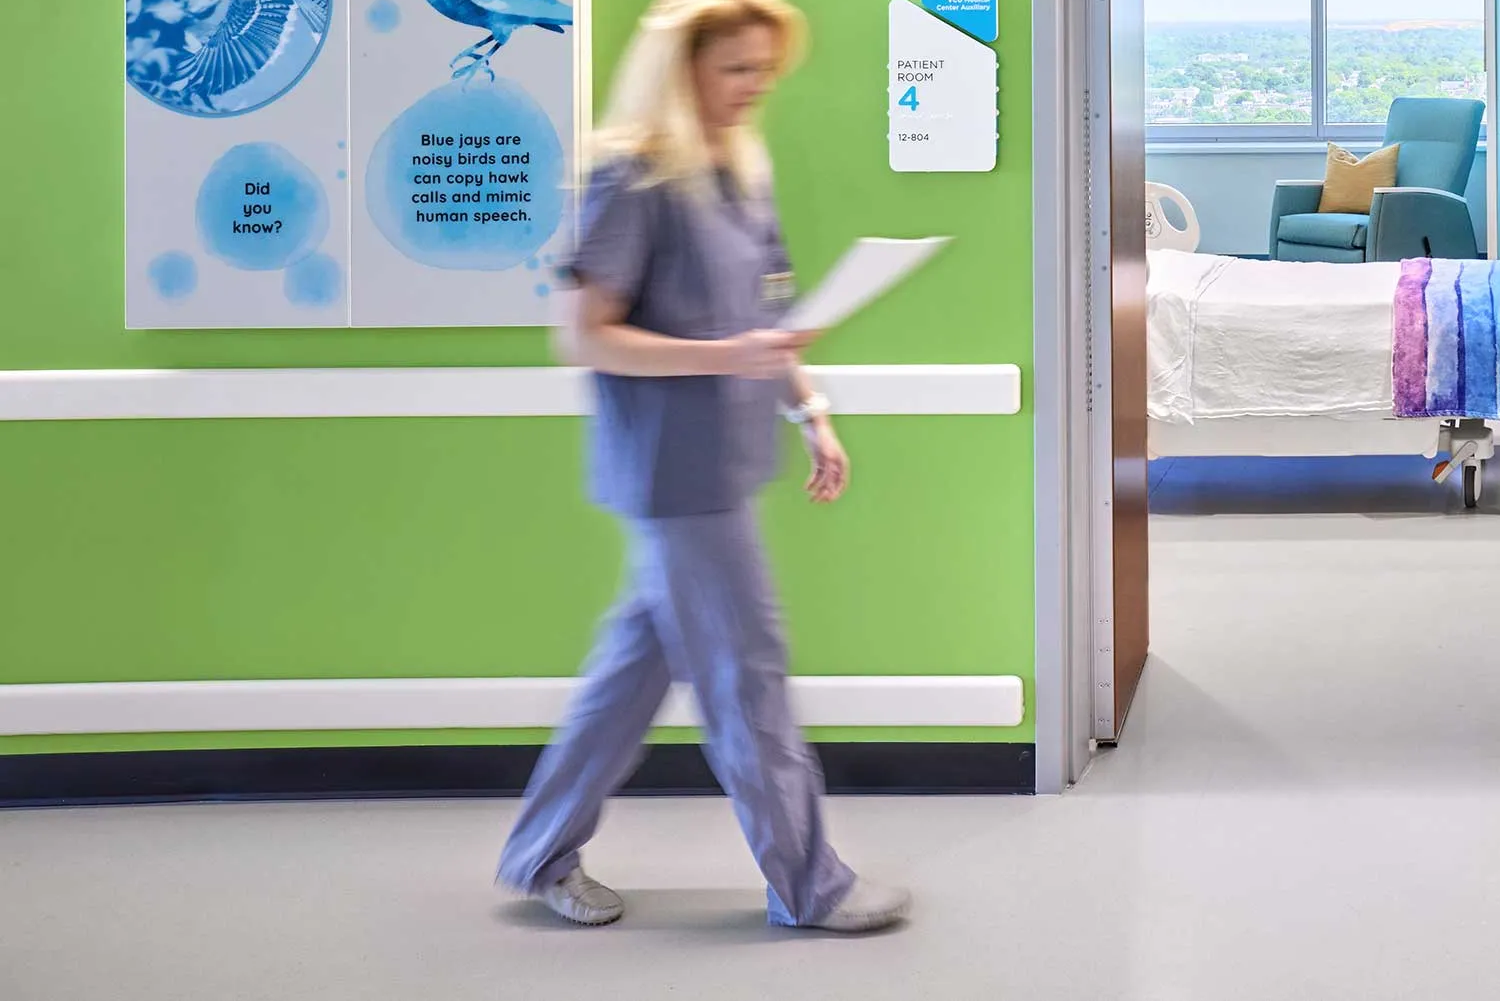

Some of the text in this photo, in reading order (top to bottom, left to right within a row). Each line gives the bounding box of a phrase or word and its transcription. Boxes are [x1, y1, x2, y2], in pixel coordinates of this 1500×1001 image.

[897, 60, 945, 70] PATIENT
[897, 72, 934, 82] ROOM
[898, 85, 920, 112] 4
[421, 133, 522, 148] Blue jays are
[898, 133, 930, 142] 12-804
[412, 152, 530, 167] noisy birds and
[413, 171, 529, 188] can copy hawk
[244, 182, 271, 196] Did
[411, 189, 532, 204] calls and mimic
[243, 203, 272, 217] you
[416, 208, 532, 224] human speech.
[232, 220, 283, 234] know?
